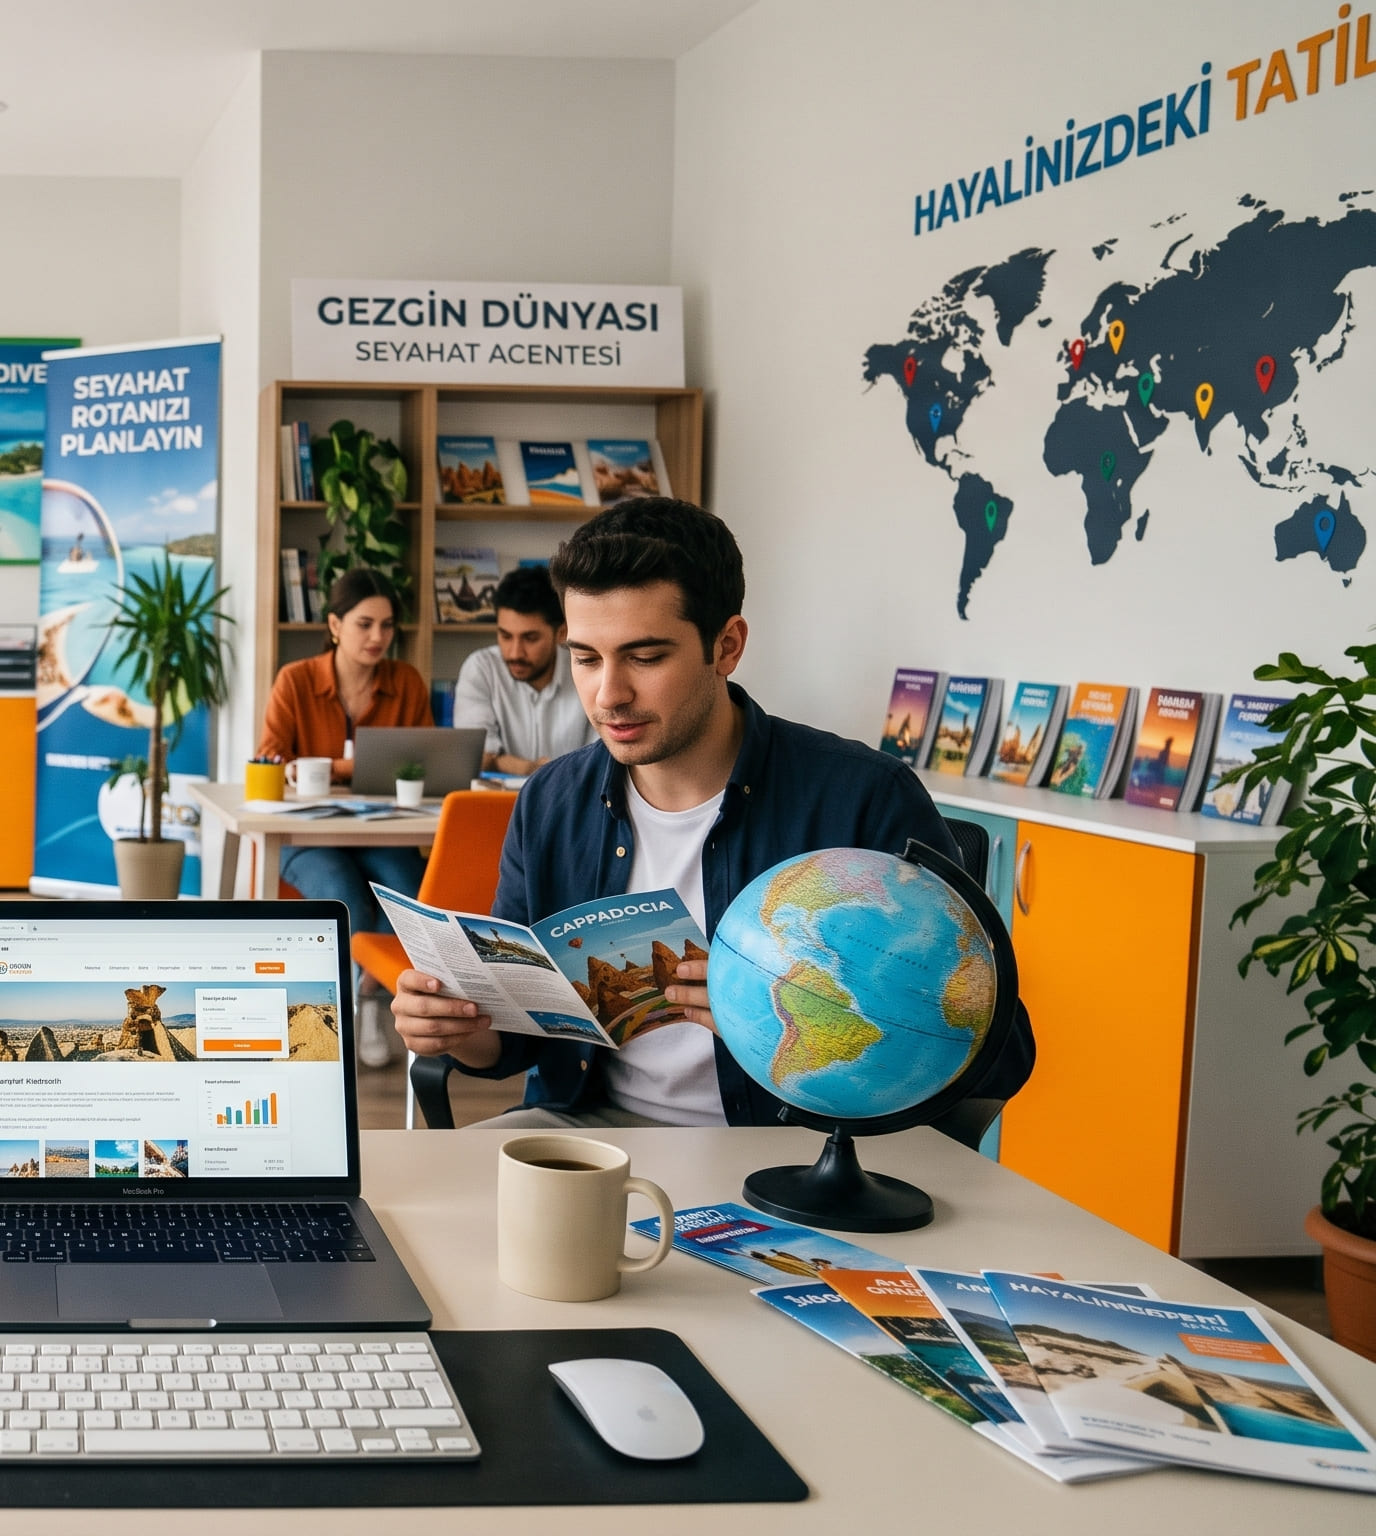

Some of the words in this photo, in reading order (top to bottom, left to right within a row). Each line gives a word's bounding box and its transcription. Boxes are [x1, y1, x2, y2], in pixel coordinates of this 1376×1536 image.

[914, 61, 1212, 236] HAYALİNİZDEKİ
[317, 290, 467, 327] GEZGİN
[482, 293, 659, 332] DÜNYASI
[355, 341, 481, 363] SEYAHAT
[488, 341, 622, 366] ACENTESİ
[73, 366, 190, 400] SEYAHAT
[71, 397, 191, 429] ROTANIZI
[60, 425, 203, 457] PLANLAYIN
[550, 900, 674, 938] CAPPADOCIA
